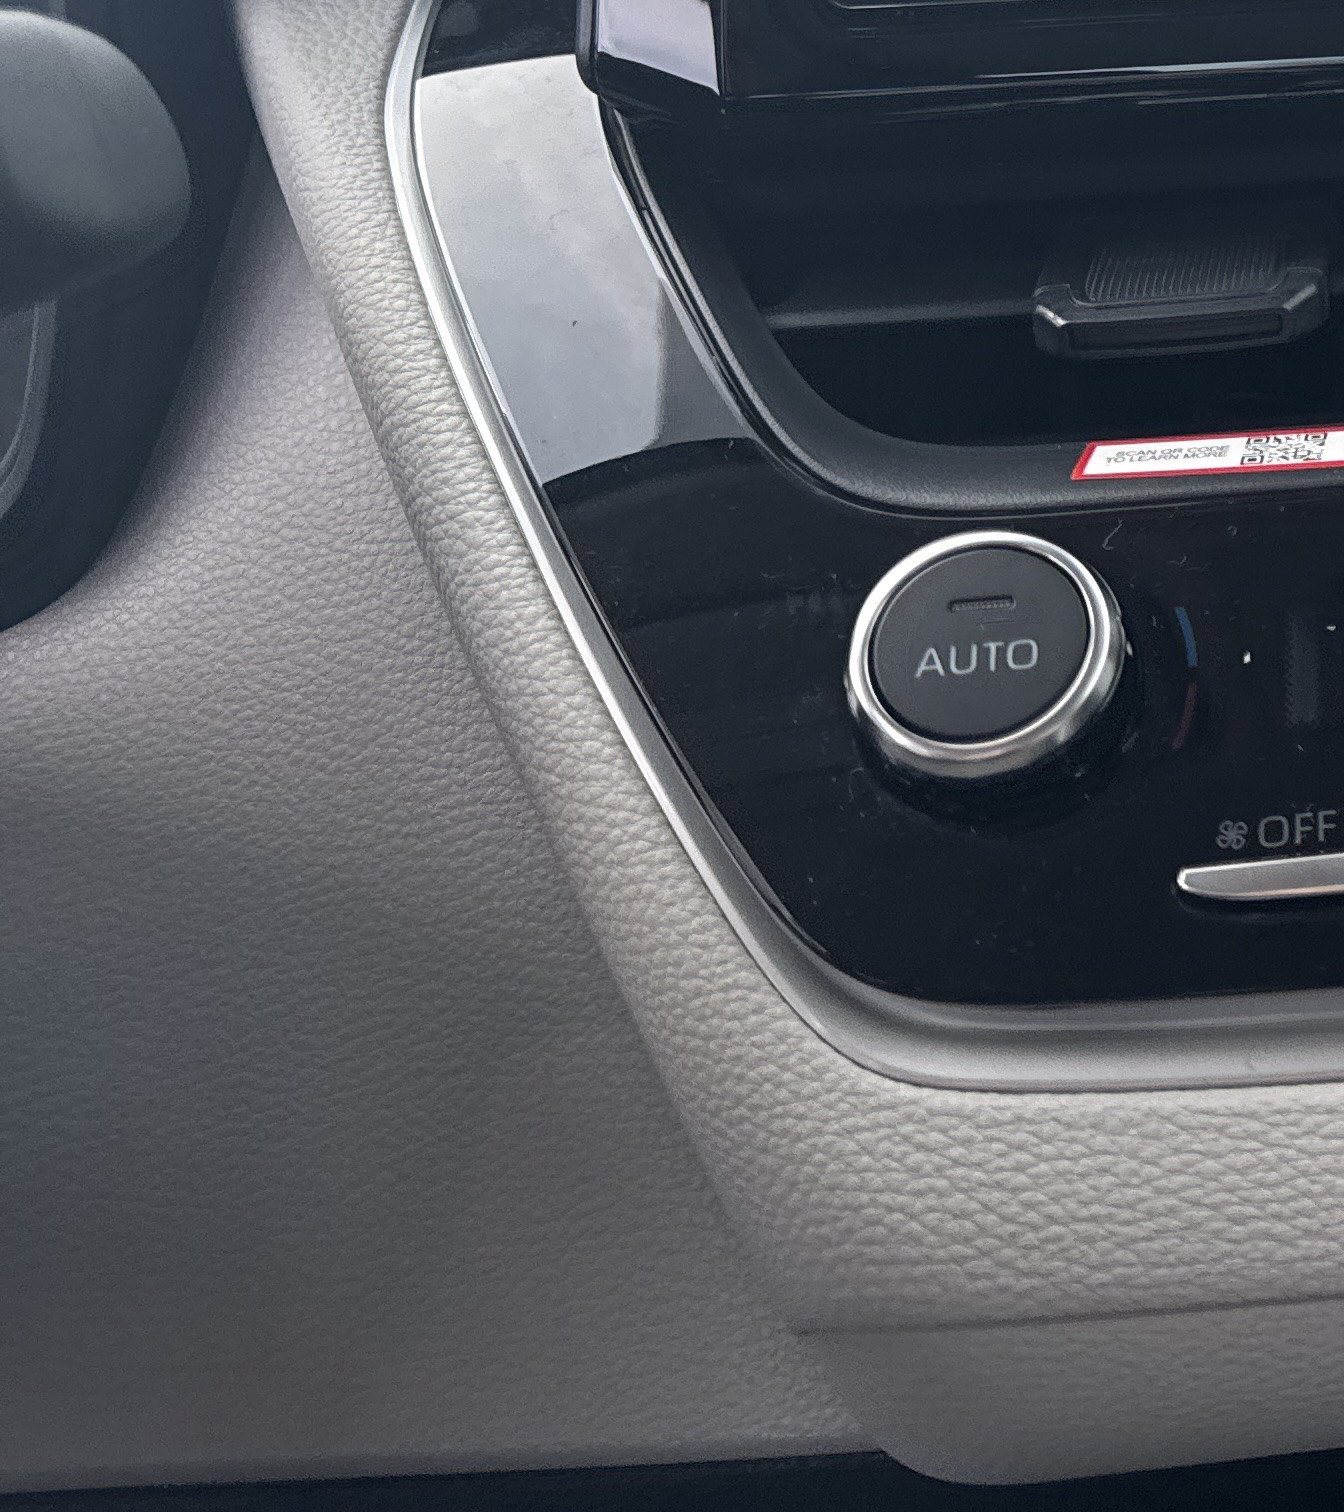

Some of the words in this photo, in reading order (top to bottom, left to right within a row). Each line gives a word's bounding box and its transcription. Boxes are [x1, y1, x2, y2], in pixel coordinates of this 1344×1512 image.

[1106, 456, 1126, 464] TO
[1129, 453, 1180, 462] LEARN
[1183, 450, 1228, 459] MORE
[914, 638, 1040, 678] AUTO
[1258, 808, 1338, 848] OFF
